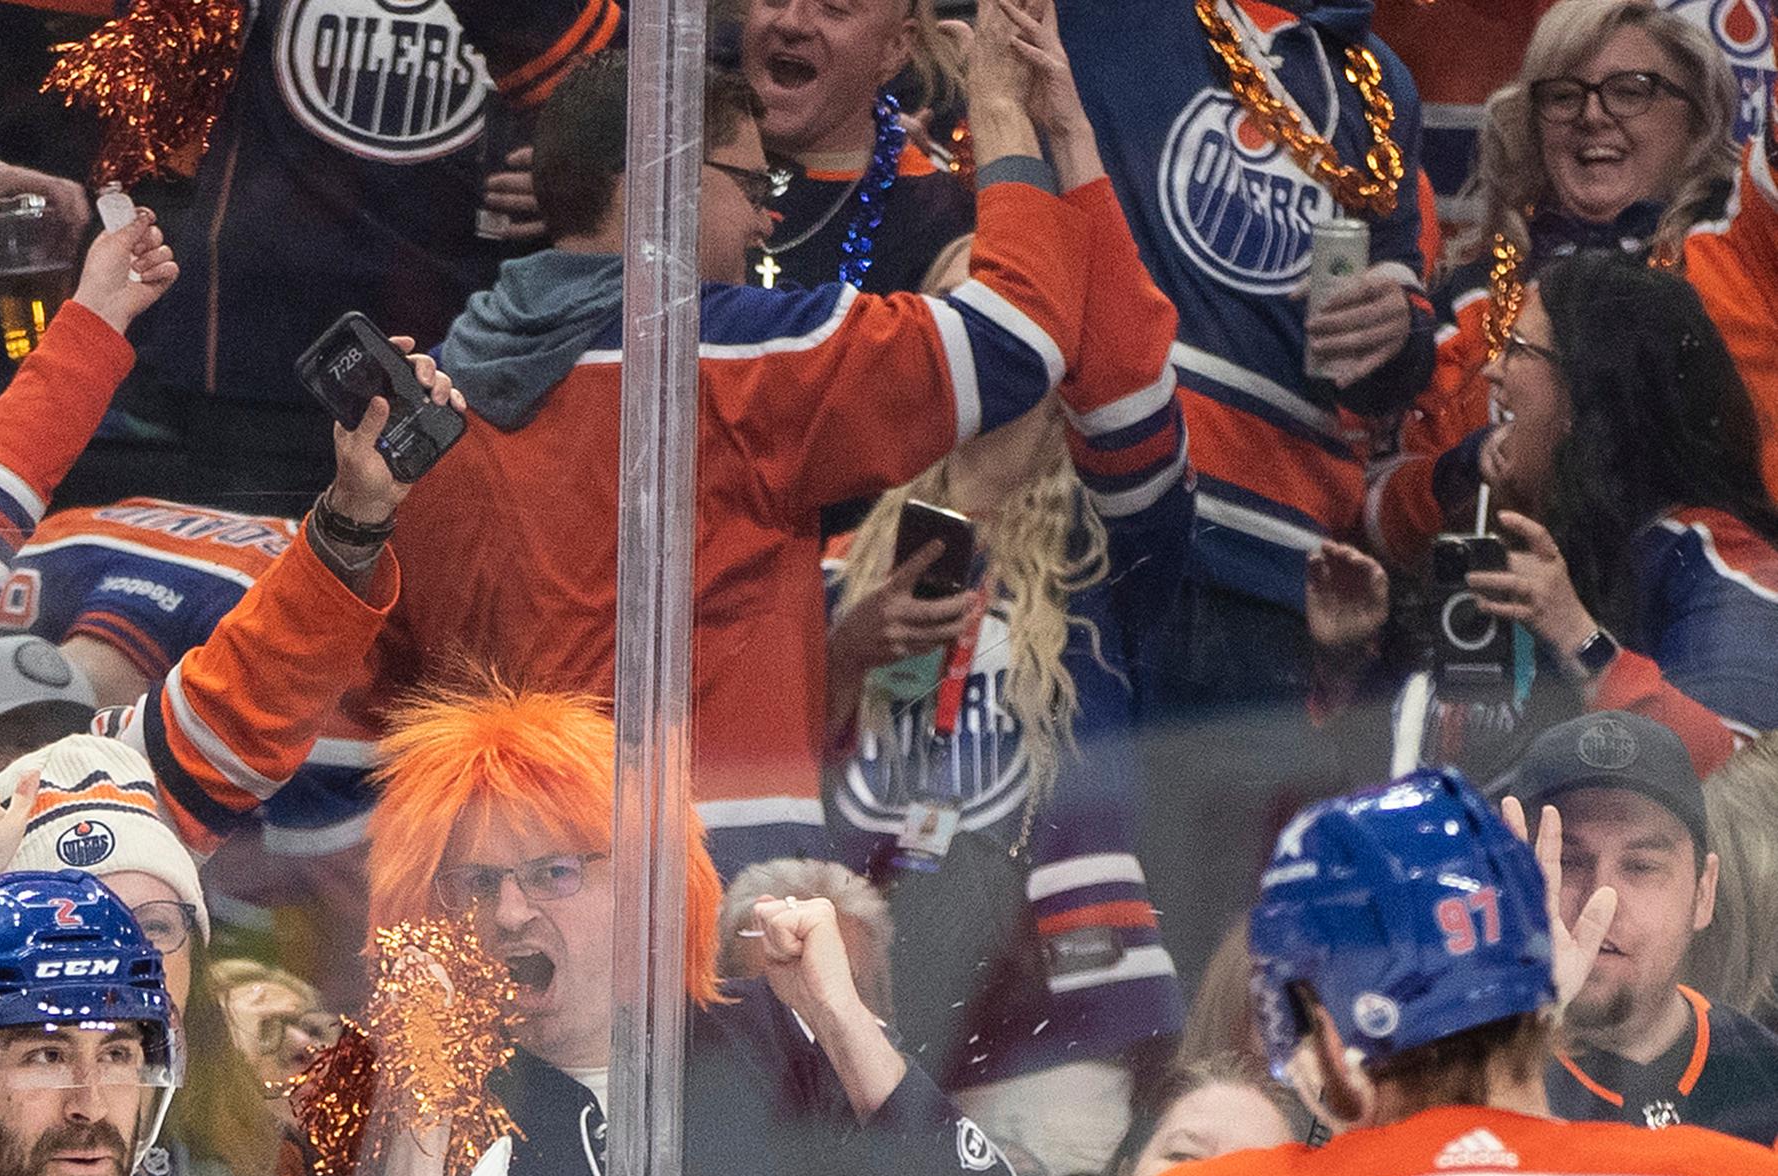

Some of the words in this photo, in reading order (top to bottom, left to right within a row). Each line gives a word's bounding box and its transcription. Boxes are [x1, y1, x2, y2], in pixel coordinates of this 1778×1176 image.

[328, 347, 364, 381] 7:28
[48, 898, 84, 927] 2
[1435, 885, 1501, 956] 97
[35, 958, 120, 979] CCM
